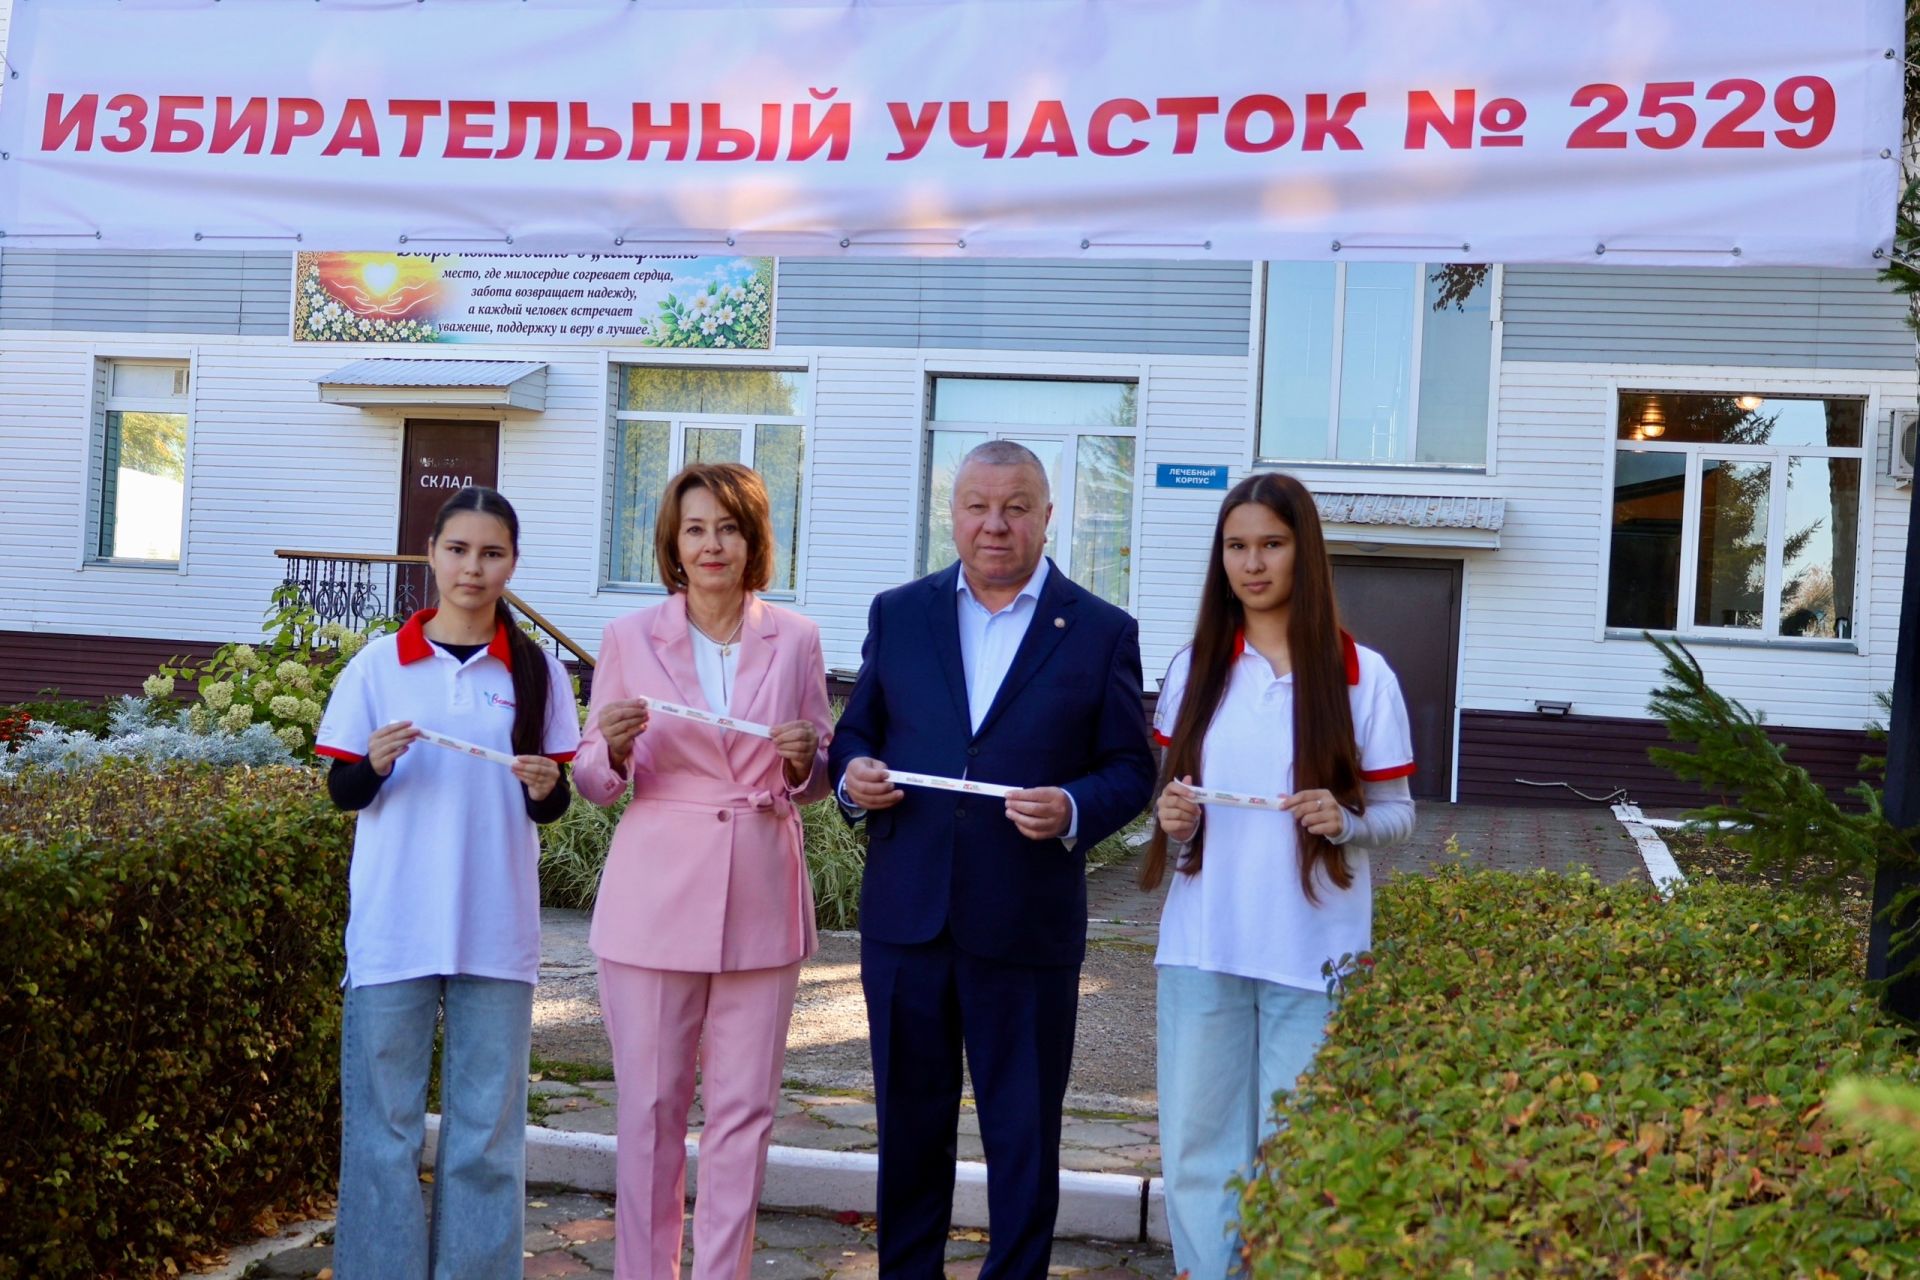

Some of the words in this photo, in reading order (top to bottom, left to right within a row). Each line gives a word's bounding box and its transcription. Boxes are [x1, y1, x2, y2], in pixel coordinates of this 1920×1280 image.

[41, 87, 852, 161] ИЗБИРАТЕЛЬНЫЙ
[886, 91, 1367, 161] УЧАСТОК
[1404, 88, 1527, 149] №
[1566, 76, 1837, 149] 2529
[442, 269, 482, 281] место,
[484, 267, 502, 280] где
[503, 267, 570, 283] милосердие
[573, 270, 630, 283] согревает
[633, 268, 674, 283] сердца,
[471, 285, 512, 298] забота
[515, 288, 584, 301] возвращает
[587, 286, 637, 301] надежду,
[468, 306, 475, 315] а
[478, 303, 523, 316] каждый
[525, 306, 568, 316] человек
[571, 306, 633, 319] встречает
[438, 322, 493, 335] уважение,
[496, 321, 557, 336] поддержку
[560, 325, 567, 334] и
[570, 325, 594, 337] веру
[597, 324, 604, 335] в
[606, 325, 650, 336] лучшее.
[1168, 468, 1216, 477] ЛЕЧЕБНЫЙ
[1175, 476, 1210, 484] КОРПУС
[420, 474, 473, 489] СКЛАД
